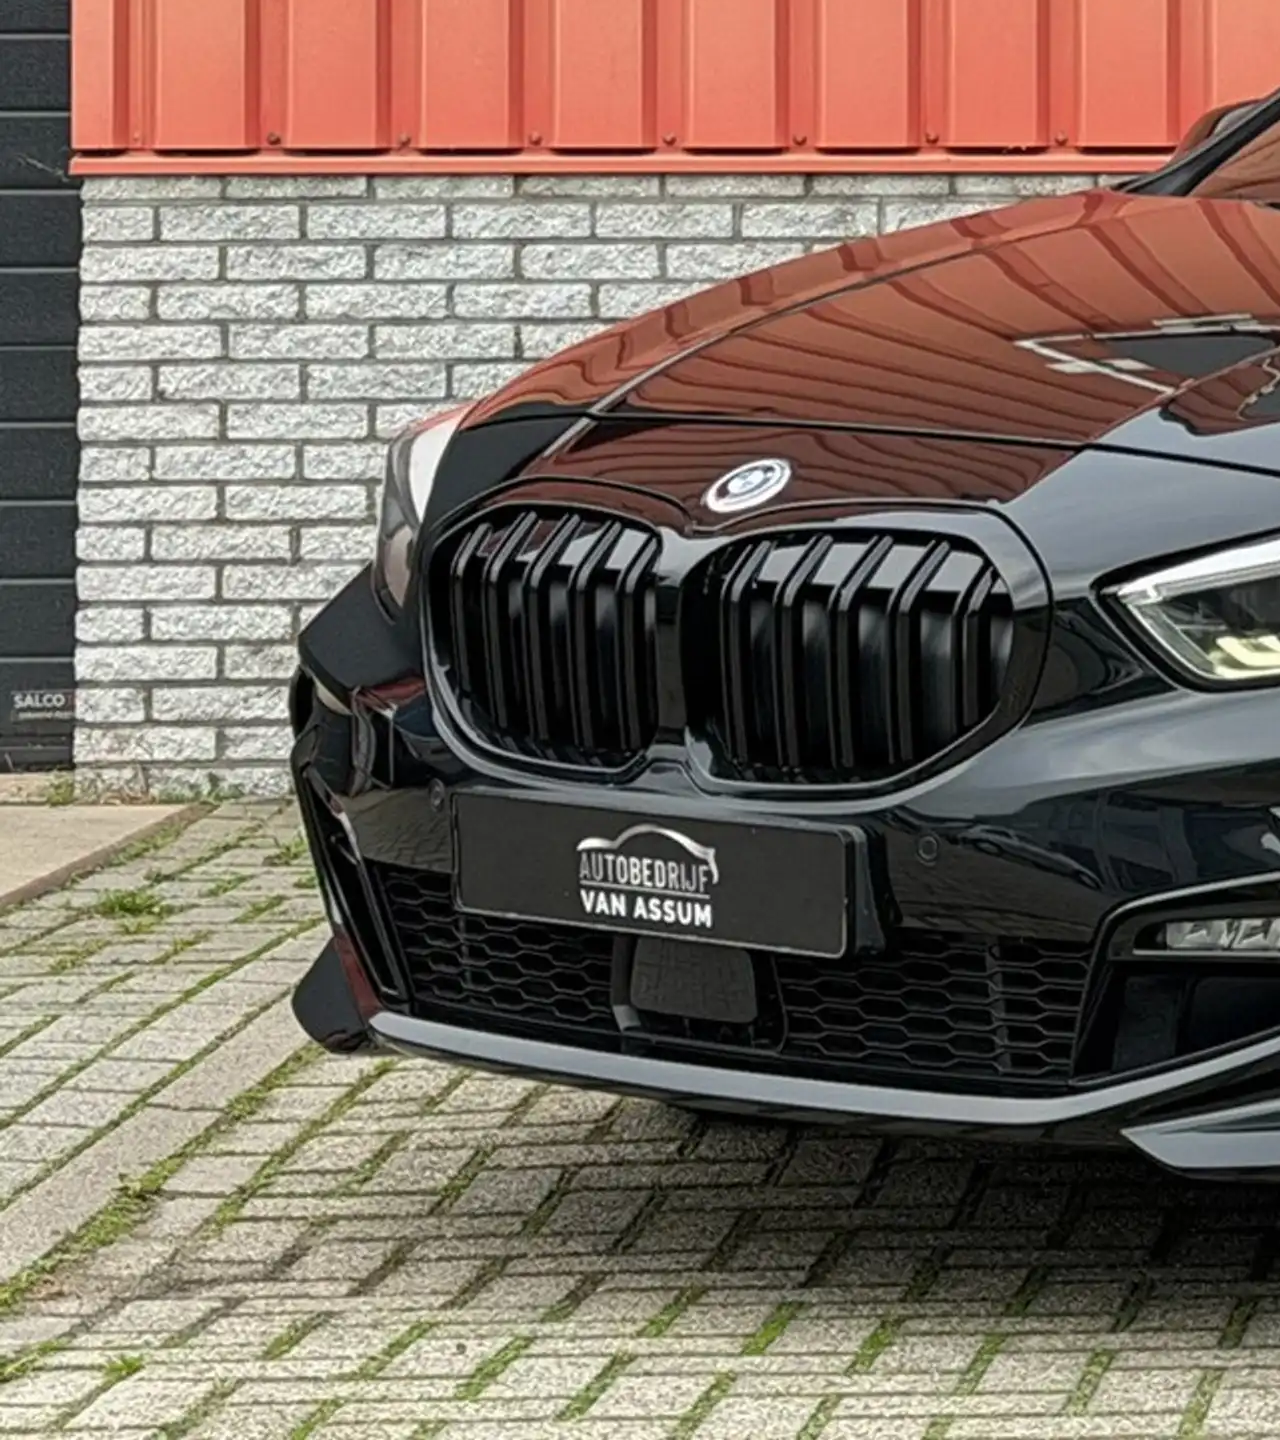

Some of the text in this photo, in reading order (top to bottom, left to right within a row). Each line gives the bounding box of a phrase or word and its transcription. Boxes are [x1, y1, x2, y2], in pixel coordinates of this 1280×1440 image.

[579, 851, 709, 893] AUTOBEDRIJF
[580, 888, 712, 929] VAN ASSUM
